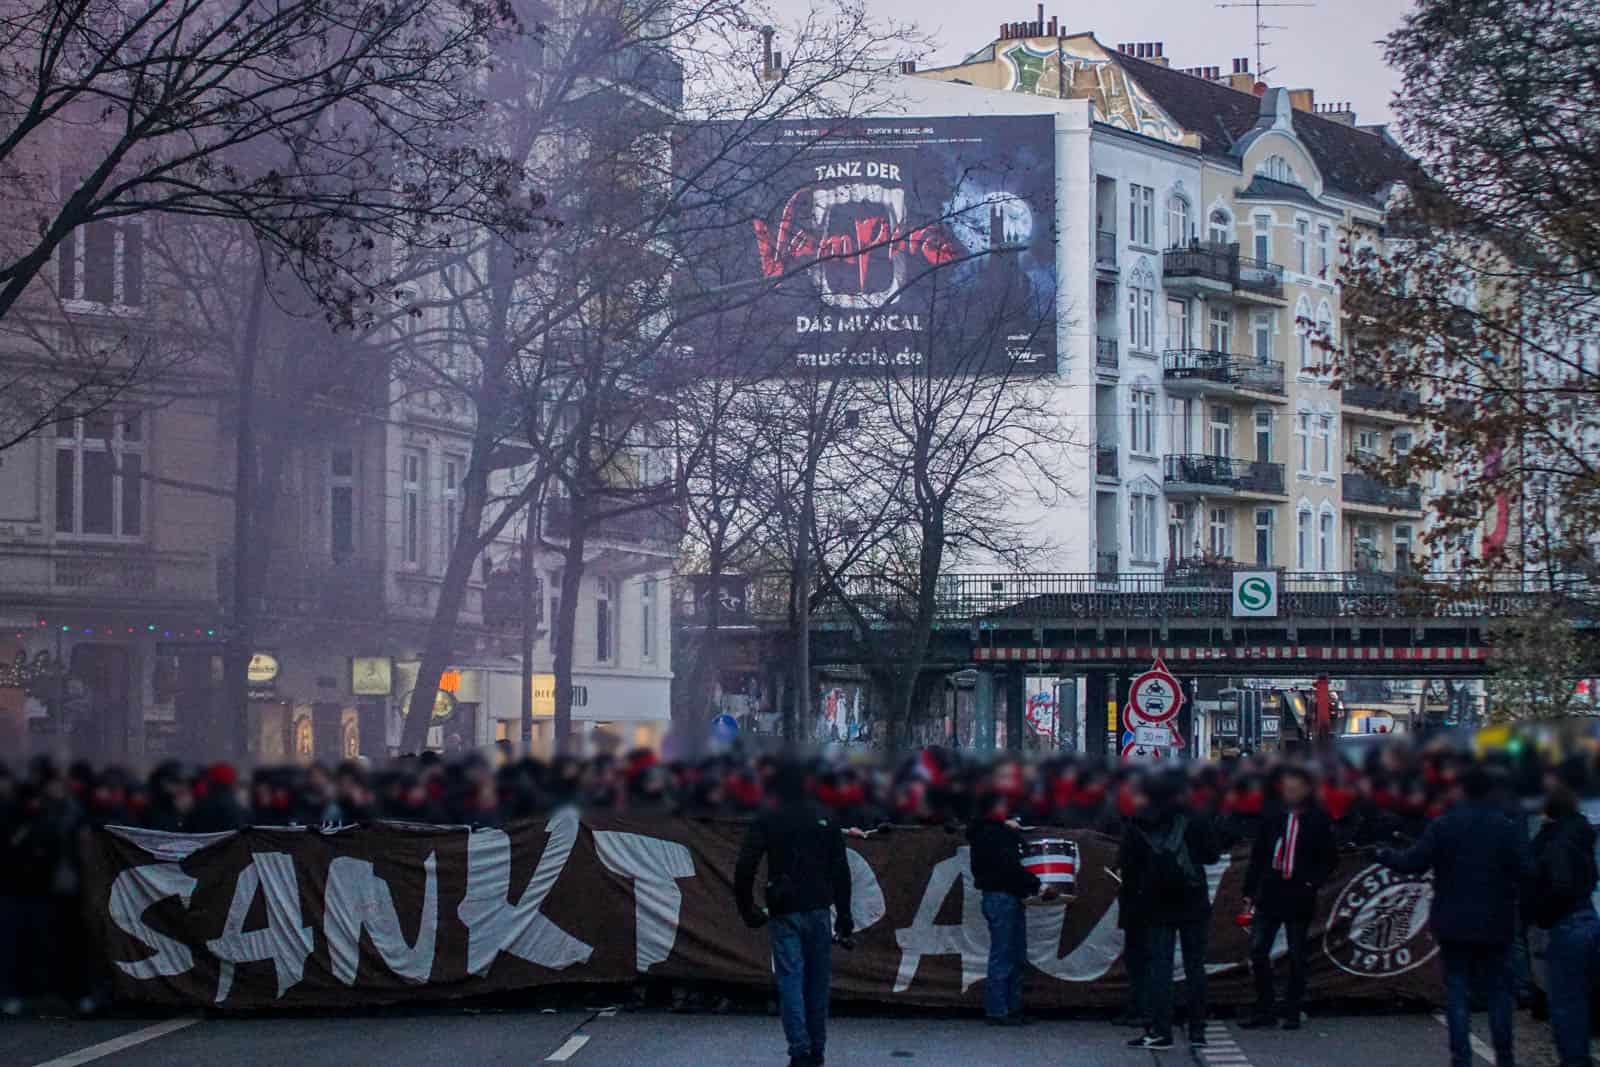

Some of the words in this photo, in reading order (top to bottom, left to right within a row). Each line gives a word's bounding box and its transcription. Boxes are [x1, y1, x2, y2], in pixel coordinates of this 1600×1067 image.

[815, 161, 862, 181] TANZ
[867, 162, 902, 181] DER
[796, 315, 832, 332] DAS
[838, 314, 923, 332] MUSICAL
[797, 346, 922, 366] musicals.de
[108, 806, 696, 1003] SANKT
[1350, 948, 1411, 970] 1910
